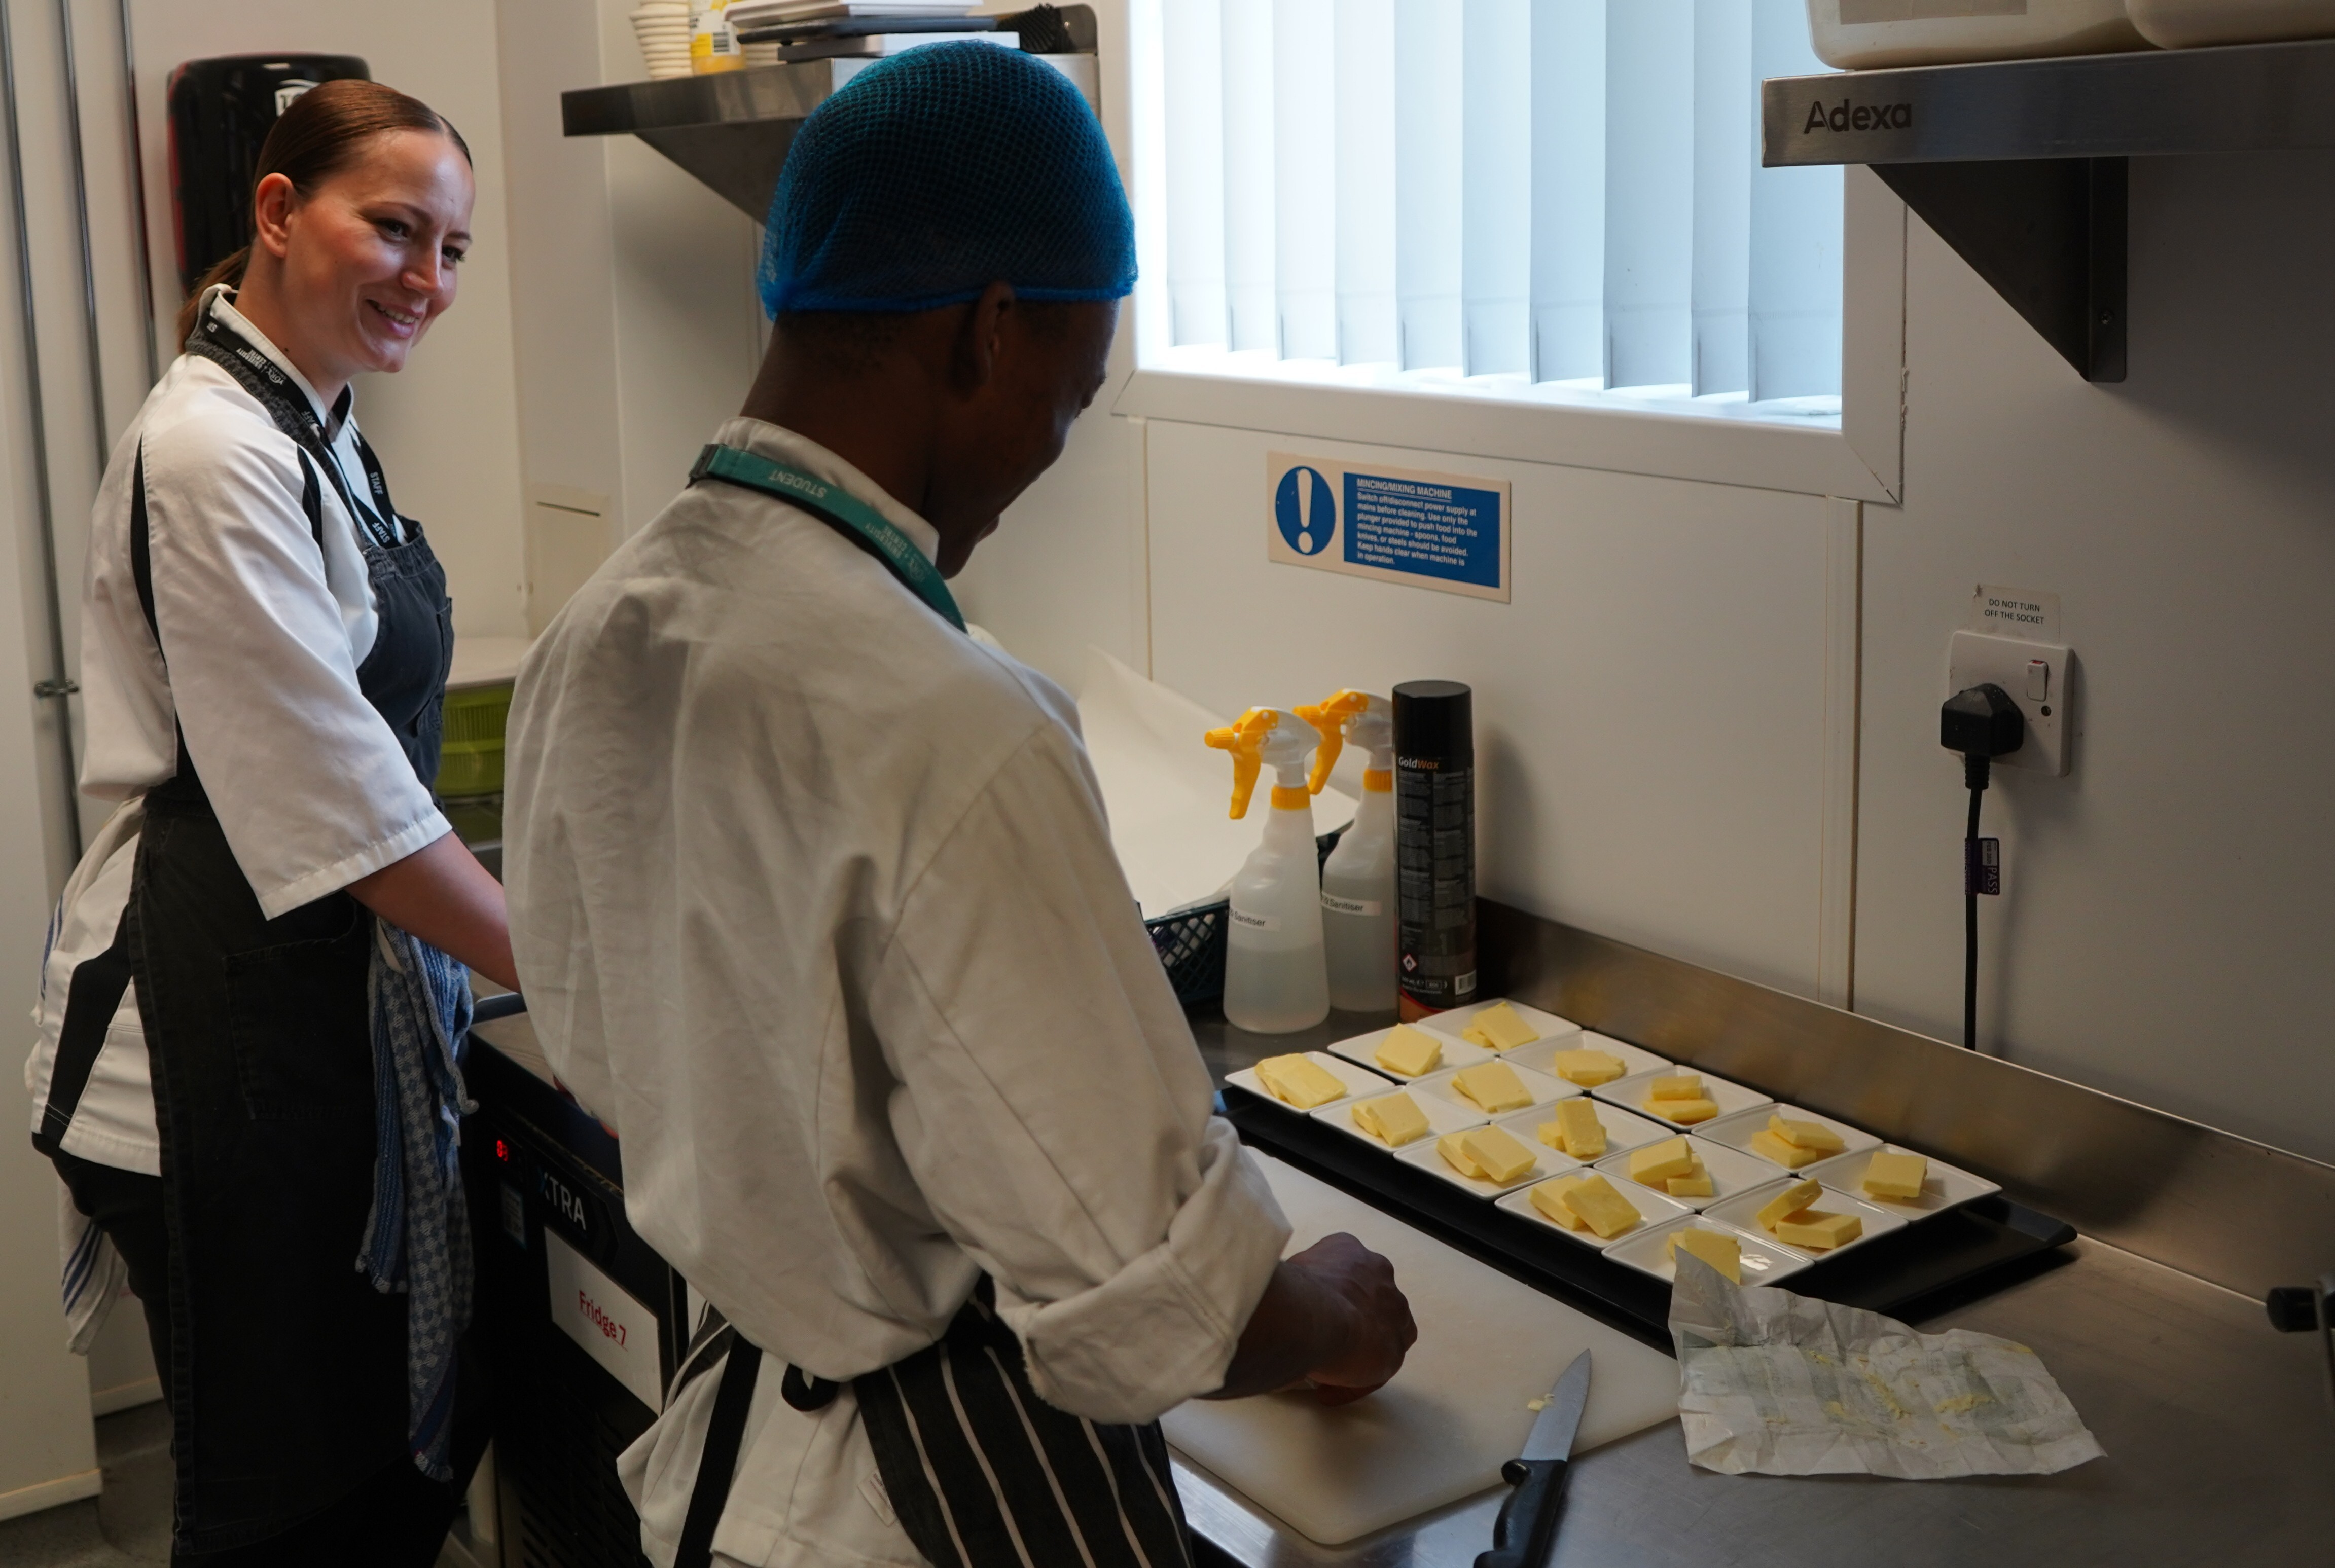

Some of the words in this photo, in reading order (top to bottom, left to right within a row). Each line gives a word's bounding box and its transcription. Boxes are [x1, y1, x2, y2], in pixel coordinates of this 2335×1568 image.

[1804, 99, 1912, 134] Adexa
[369, 471, 383, 495] STAFF
[769, 469, 827, 498] STUDENT
[1357, 478, 1415, 495] MINCING/MIXING
[1417, 486, 1452, 499] MACHINE
[1357, 492, 1378, 502] Switch
[1379, 495, 1423, 509] off/disconnect
[1425, 503, 1445, 512] power
[1446, 506, 1468, 517] supply
[1357, 503, 1376, 512] mains
[1377, 505, 1396, 515] before
[1428, 512, 1440, 521] Use
[1442, 516, 1456, 525] only
[1458, 517, 1468, 526] the
[372, 522, 390, 543] STAFF
[1357, 513, 1381, 524] plunger
[1382, 517, 1410, 527] provided
[1418, 522, 1435, 530] push
[1436, 524, 1451, 533] food
[1453, 526, 1465, 535] into
[1466, 528, 1478, 537] the
[1357, 523, 1382, 534] mincing
[1383, 527, 1409, 537] machine
[1441, 535, 1457, 544] food
[1357, 541, 1373, 552] Keep
[1374, 544, 1393, 554] hands
[1395, 548, 1410, 557] clear
[1411, 551, 1428, 560] when
[1430, 554, 1457, 565] machine
[1459, 558, 1465, 566] is
[1388, 537, 1407, 546] steels
[1408, 540, 1429, 550] should
[1431, 543, 1440, 552] be
[1441, 546, 1468, 557] avoided.
[1989, 598, 2000, 606] DO
[2002, 600, 2017, 609] NOT
[2020, 603, 2040, 612] TURN
[2001, 611, 2014, 620] THE
[2016, 613, 2044, 624] SOCKET
[1398, 756, 1439, 770] GoldWax
[1987, 867, 1998, 894] PASS
[1330, 898, 1363, 912] Sanitiser
[1234, 911, 1266, 927] Sanitiser
[536, 1166, 587, 1230] XTRA
[579, 1290, 617, 1338] Fridge
[618, 1325, 627, 1346] 7
